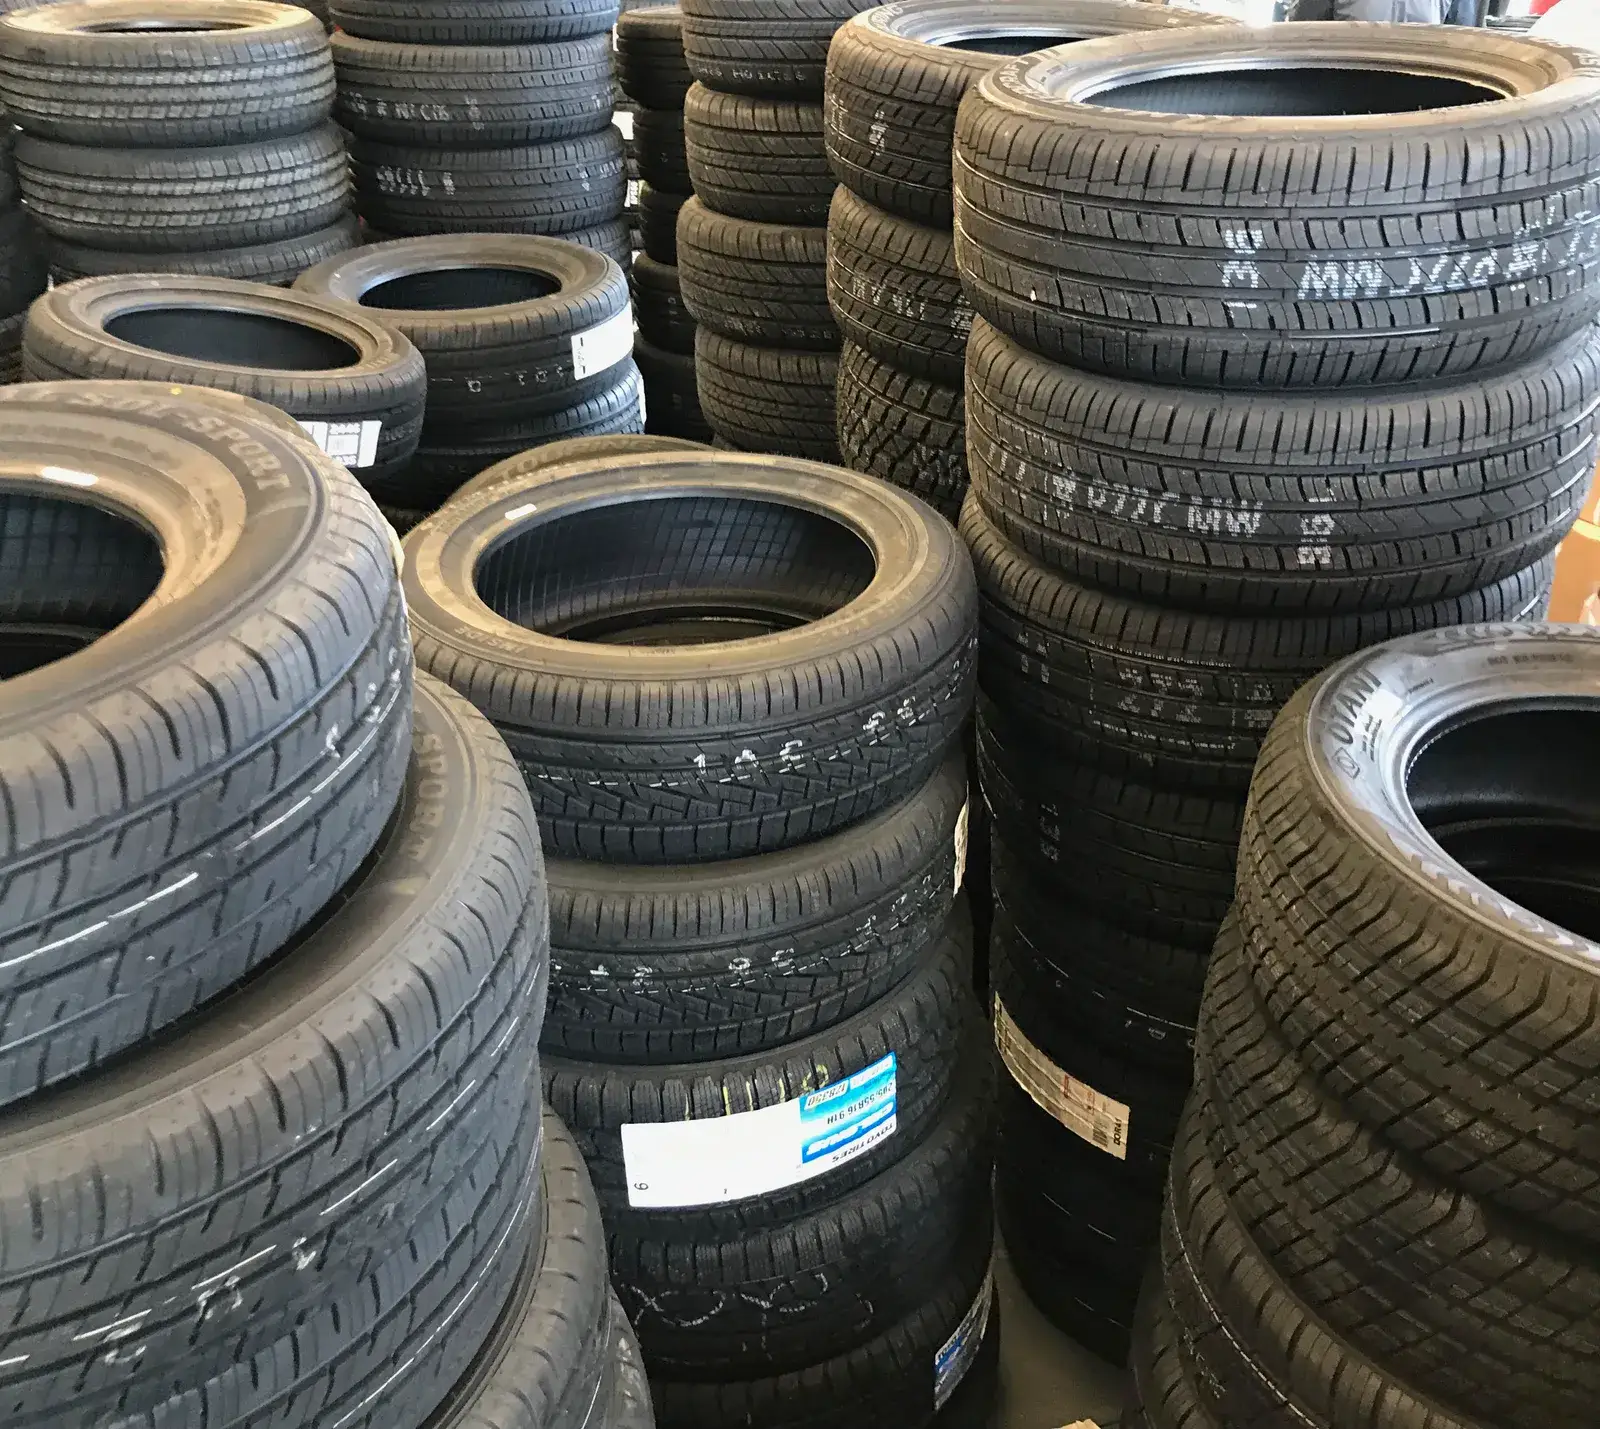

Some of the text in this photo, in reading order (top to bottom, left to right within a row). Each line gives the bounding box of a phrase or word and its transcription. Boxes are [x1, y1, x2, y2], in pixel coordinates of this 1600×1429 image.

[1329, 668, 1382, 746] OTANI
[827, 1110, 845, 1124] 91H
[867, 1123, 893, 1145] TOYO
[832, 1141, 865, 1162] TIRES
